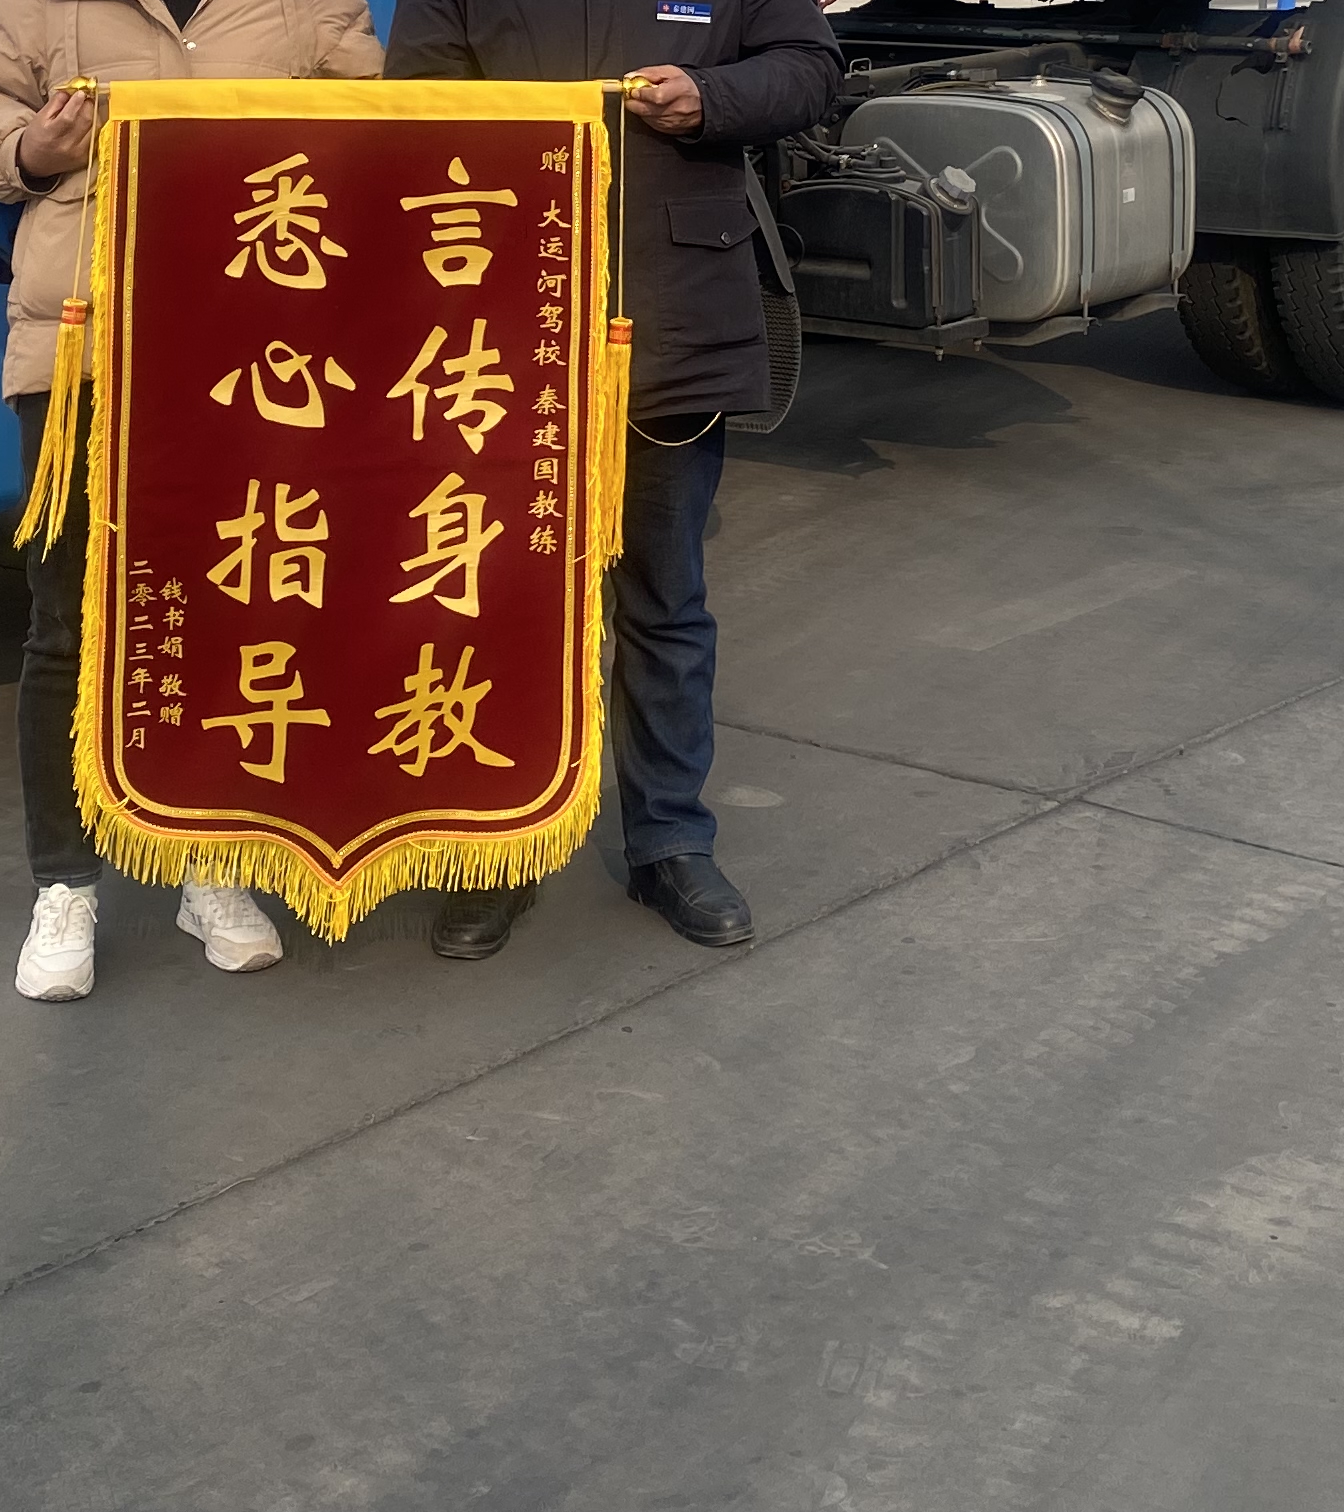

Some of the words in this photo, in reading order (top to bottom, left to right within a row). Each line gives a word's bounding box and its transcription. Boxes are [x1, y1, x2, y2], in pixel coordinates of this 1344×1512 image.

[538, 145, 570, 176] 赠
[531, 198, 570, 368] 大运河驾校
[200, 152, 356, 784] 悉心指导
[367, 156, 518, 778] 言传身教
[528, 384, 566, 555] 秦建国教练
[125, 559, 157, 750] 二零二三年二月
[157, 577, 188, 659] 钱书娟
[158, 674, 187, 727] 敬赠
